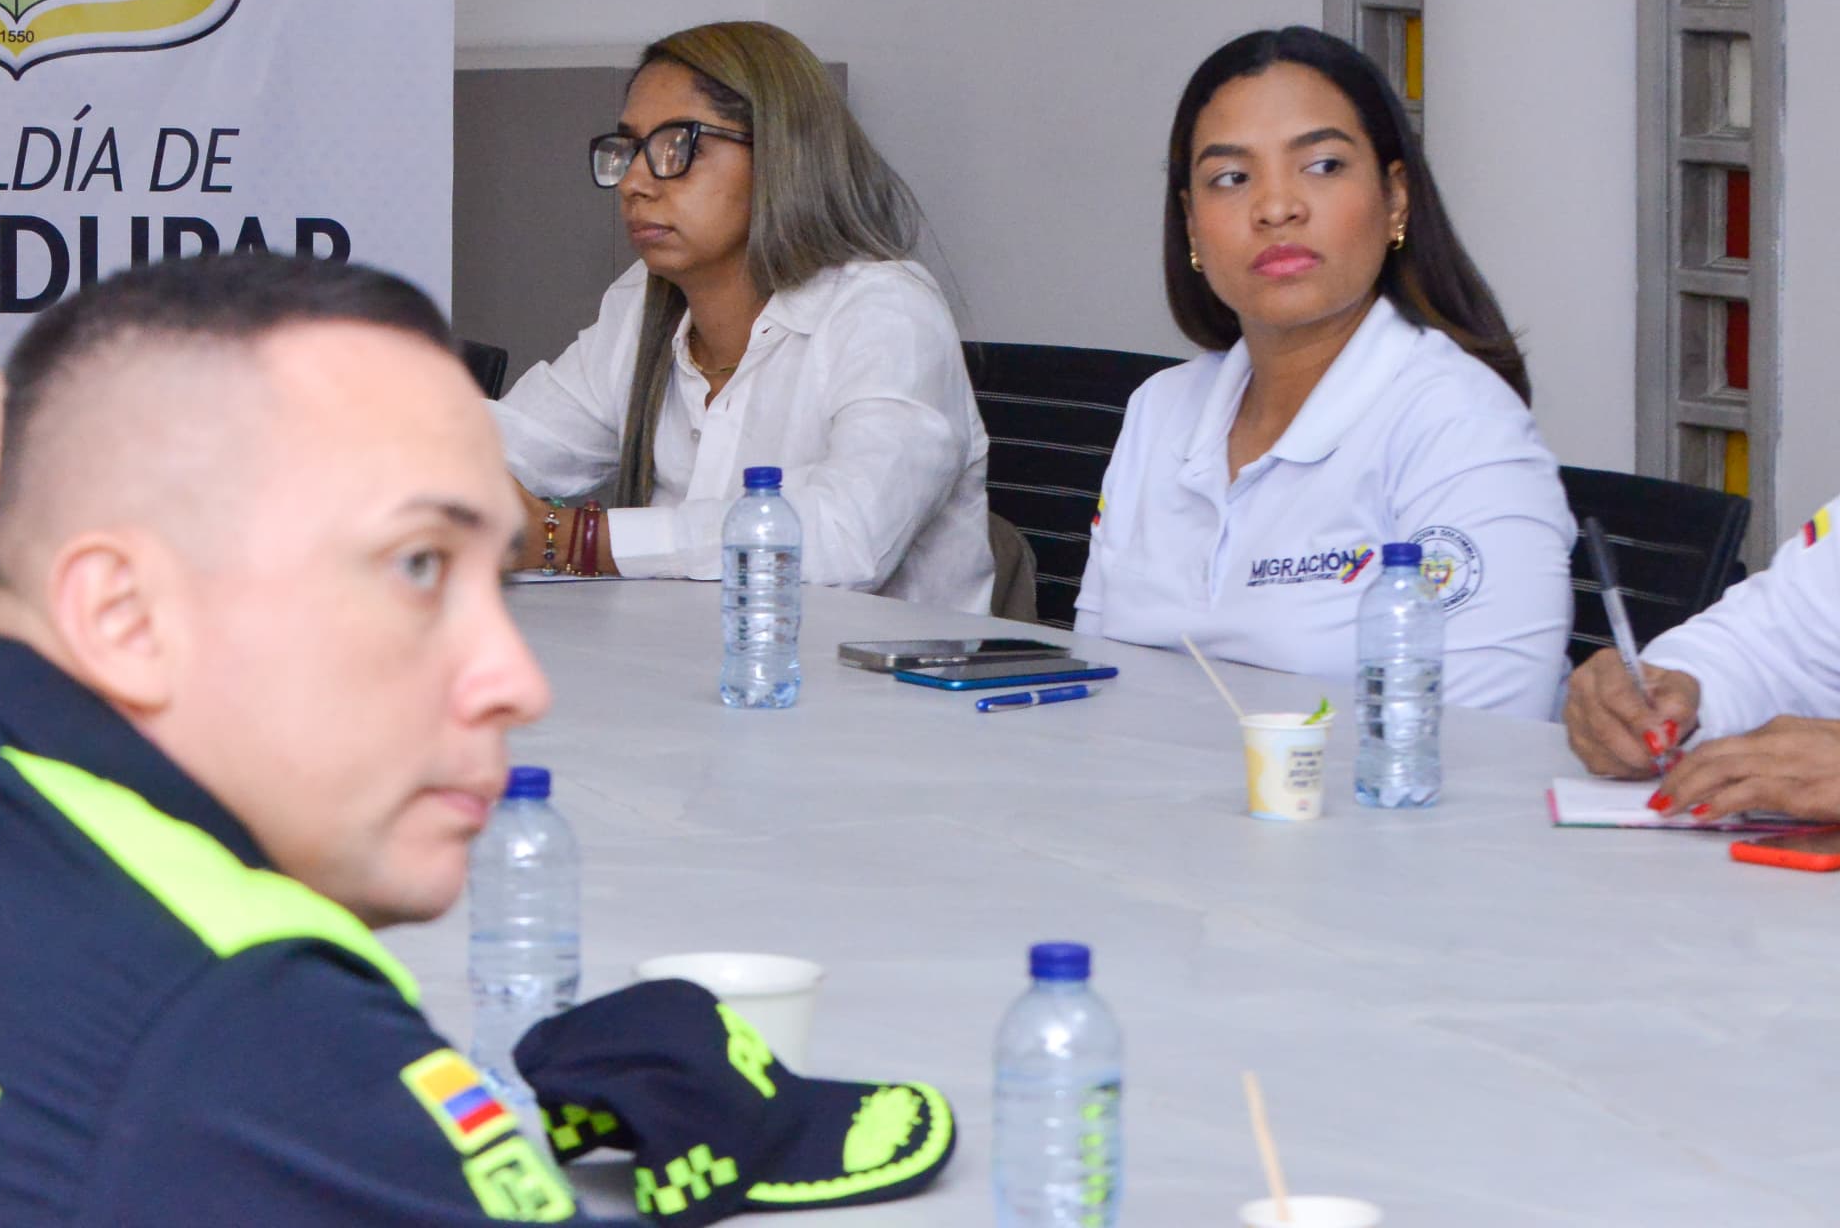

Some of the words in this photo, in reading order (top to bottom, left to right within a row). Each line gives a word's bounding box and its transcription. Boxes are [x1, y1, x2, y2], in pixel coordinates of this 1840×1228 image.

[0, 29, 35, 44] 1550
[148, 127, 240, 193] DE
[1249, 547, 1359, 579] MIGRACIÓN
